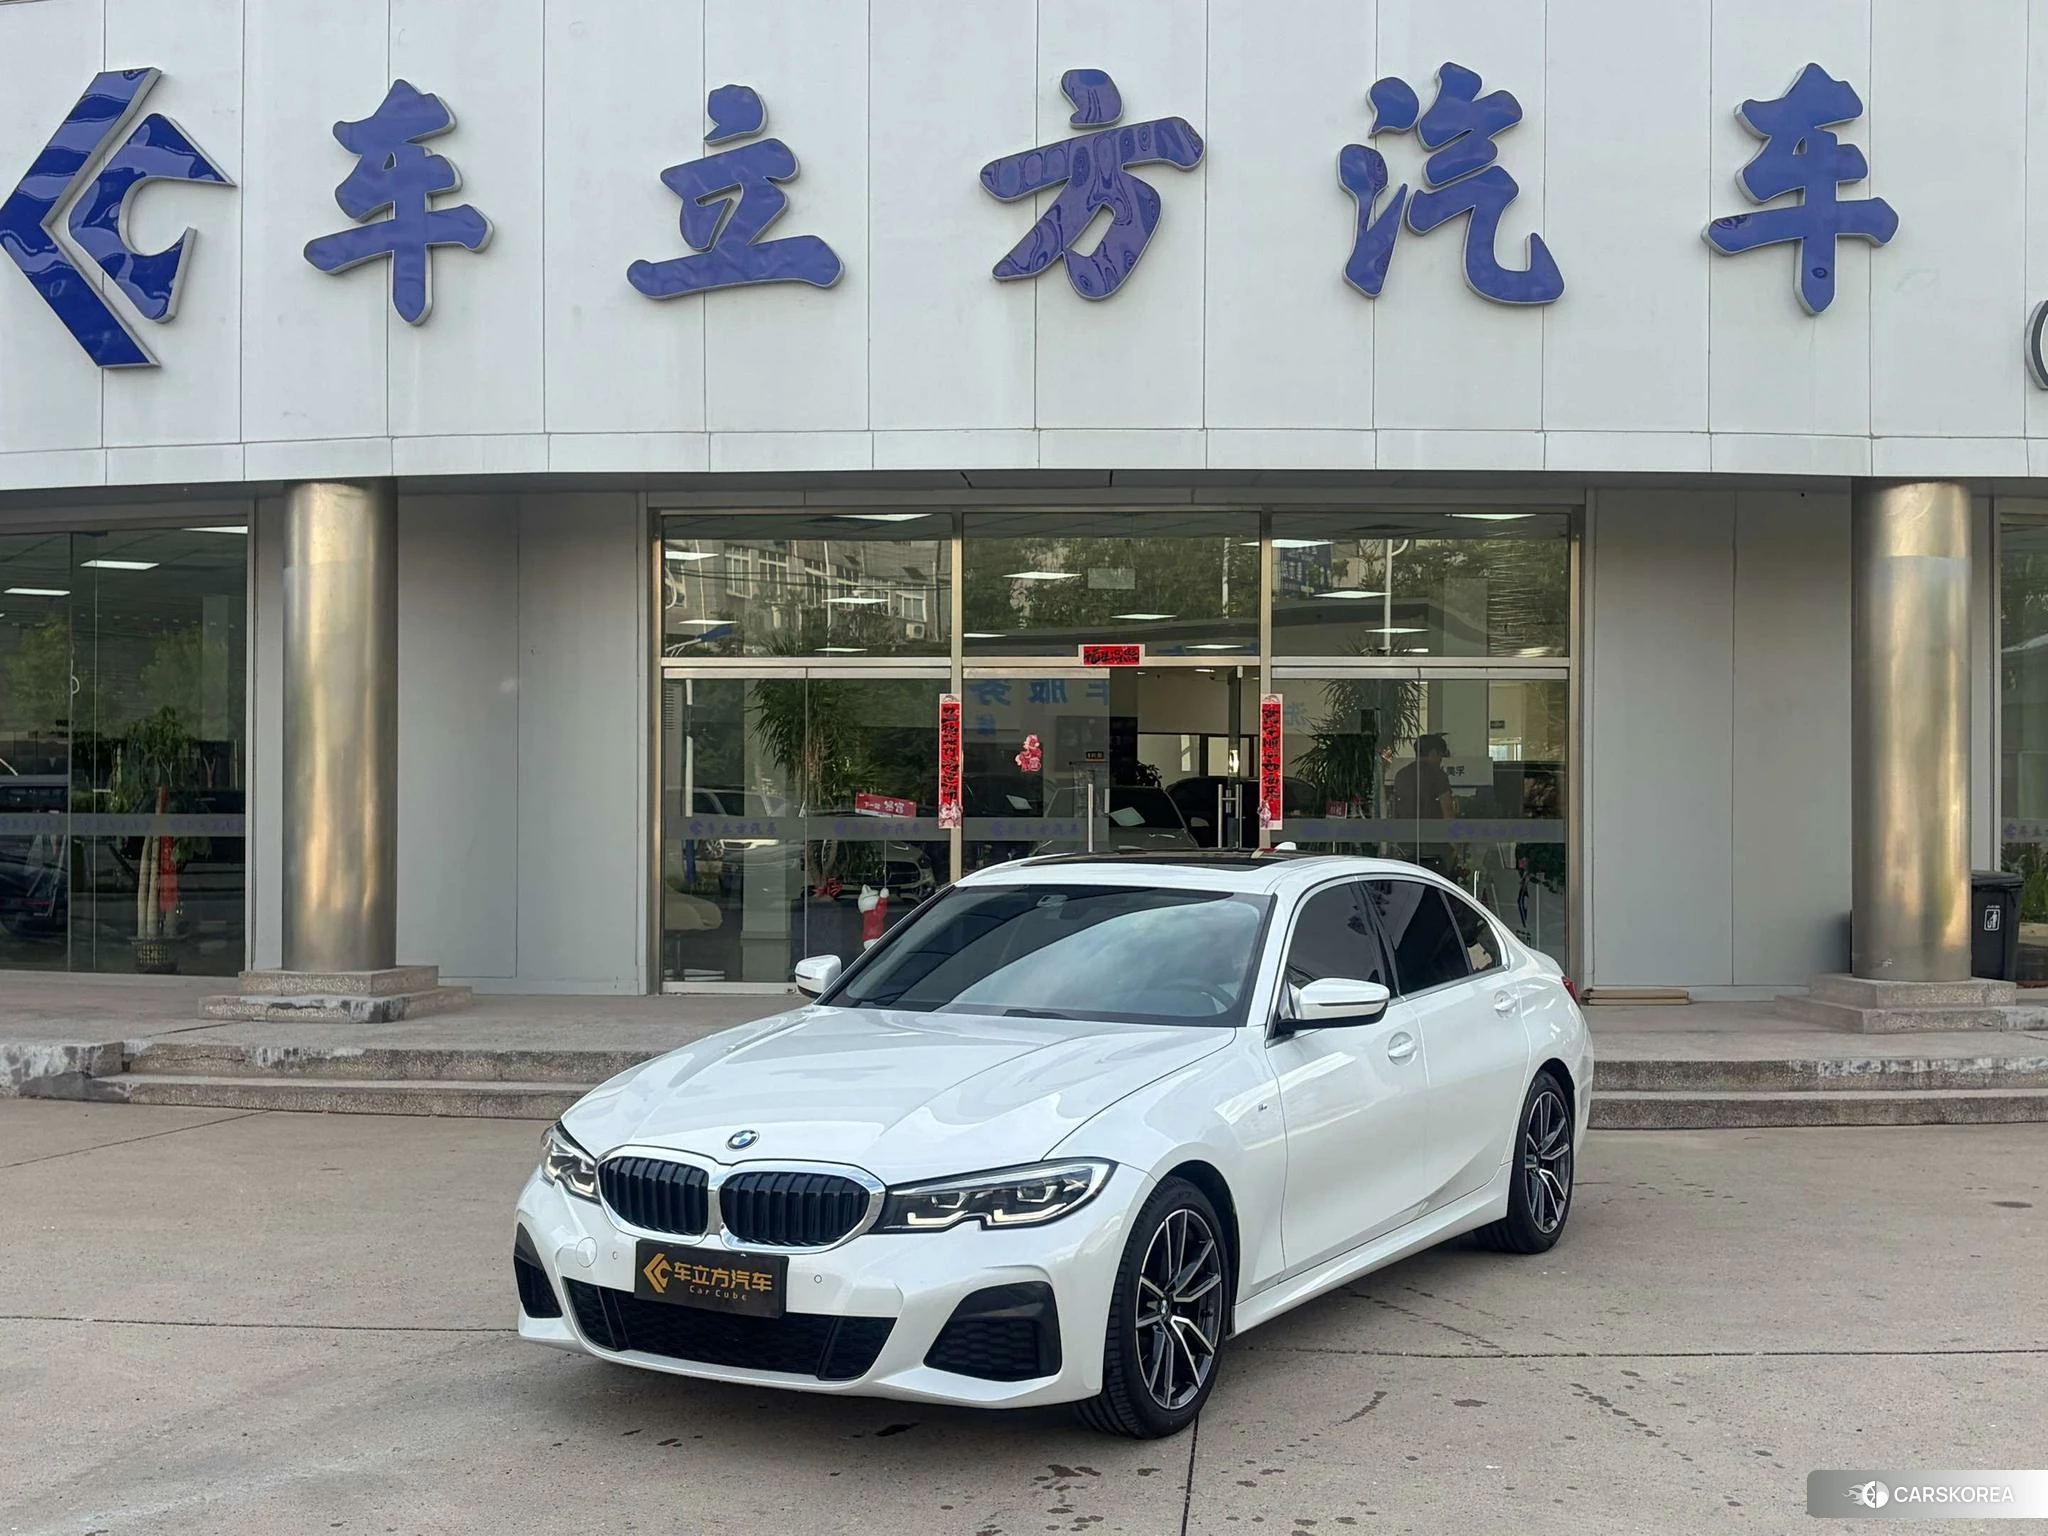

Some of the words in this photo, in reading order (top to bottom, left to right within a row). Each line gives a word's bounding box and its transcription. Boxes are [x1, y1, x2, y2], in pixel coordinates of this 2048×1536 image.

[304, 62, 1898, 327] 车立方汽车
[673, 1261, 773, 1292] 车立方汽车
[689, 1284, 710, 1296] Car
[715, 1289, 748, 1301] Cube
